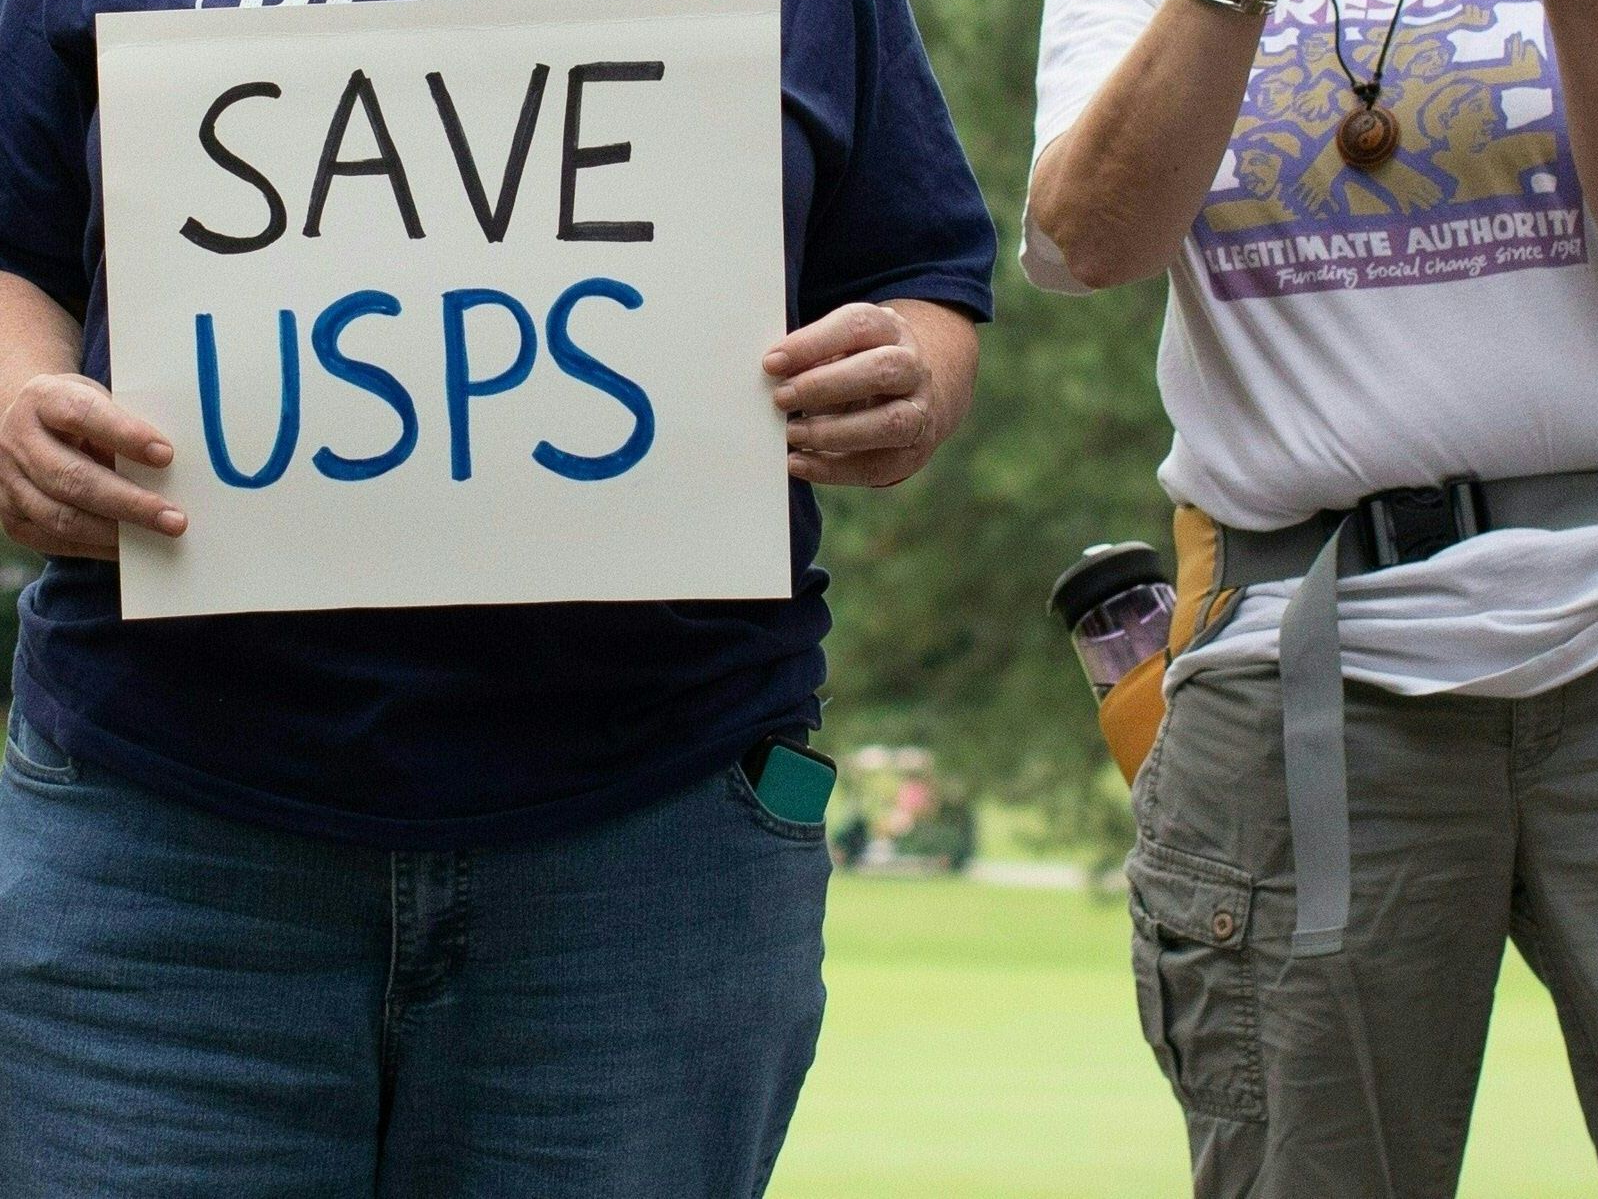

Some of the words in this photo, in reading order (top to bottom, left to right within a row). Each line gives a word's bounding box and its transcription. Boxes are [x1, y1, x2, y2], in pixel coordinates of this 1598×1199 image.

[179, 61, 665, 255] SAVE
[1276, 264, 1359, 289] Funding
[1407, 209, 1579, 254] AUTHORITY
[196, 277, 656, 490] USPS
